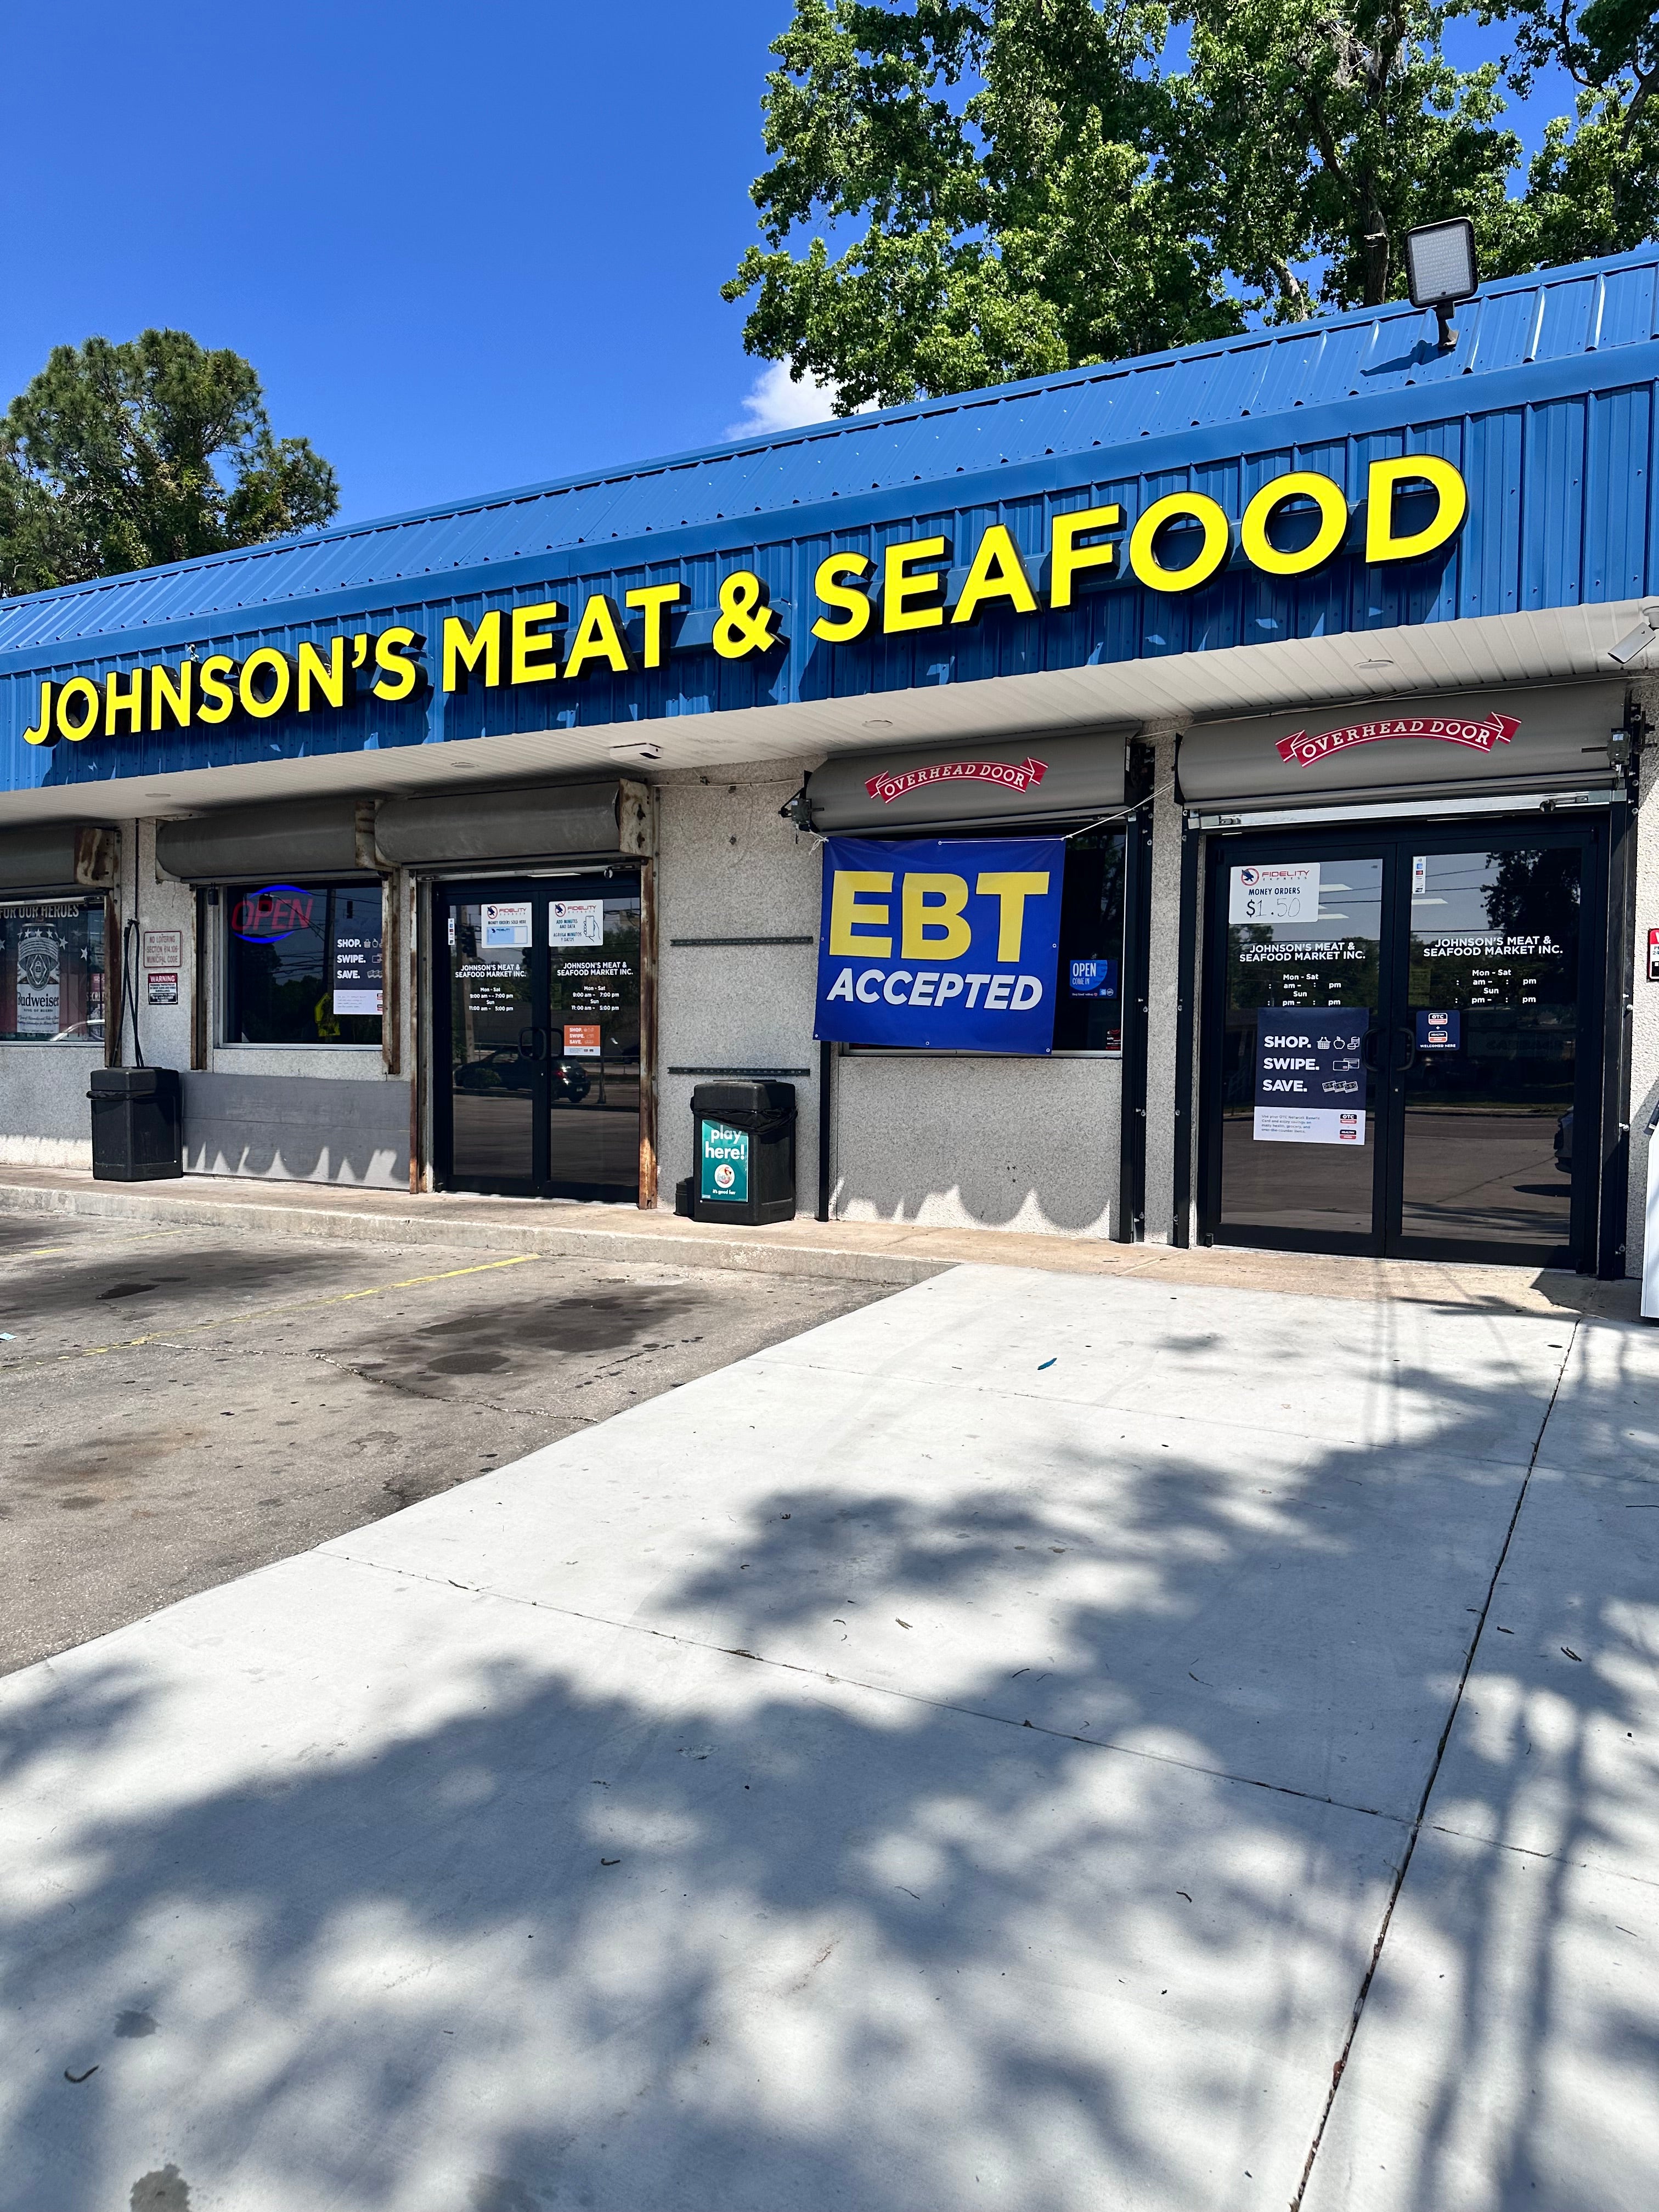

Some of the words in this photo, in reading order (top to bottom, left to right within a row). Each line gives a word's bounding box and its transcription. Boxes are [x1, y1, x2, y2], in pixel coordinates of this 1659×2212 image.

[22, 627, 416, 745] JOHNSON'S
[443, 582, 680, 692] MEAT
[712, 571, 773, 658] &
[810, 454, 1468, 643] SEAFOOD
[1302, 720, 1423, 758] OVERHEAD
[1430, 721, 1491, 746] DOOR
[884, 765, 975, 796] OVERHEAD
[979, 765, 1025, 787] DOOR
[1246, 898, 1301, 917] $1.50
[232, 899, 313, 932] OPEN
[830, 870, 1050, 962] EBT
[337, 939, 362, 948] SHOP.
[1250, 943, 1312, 953] JOHNSON'S
[1315, 942, 1345, 951] MEAT
[1347, 942, 1355, 950] &
[1435, 937, 1503, 947] JOHNSON'S
[1507, 936, 1539, 945] MEAT
[1543, 935, 1551, 944] &
[1239, 952, 1291, 962] SEAFOOD
[1295, 951, 1340, 960] MARKET
[1343, 951, 1365, 960] INC.
[1423, 947, 1481, 957] SEAFOOD
[1485, 945, 1535, 955] MARKET
[1538, 945, 1563, 954] INC.
[337, 954, 366, 963] SWIPE.
[337, 970, 360, 979] SAVE.
[1073, 963, 1097, 977] OPEN
[826, 968, 1043, 1010] ACCEPTED
[17, 992, 59, 1007] Budweiser
[1263, 1036, 1312, 1048] SHOP.
[1263, 1057, 1319, 1070] SWIPE.
[1262, 1079, 1308, 1092] SAVE.
[711, 1125, 742, 1144] play
[705, 1141, 746, 1160] here!
